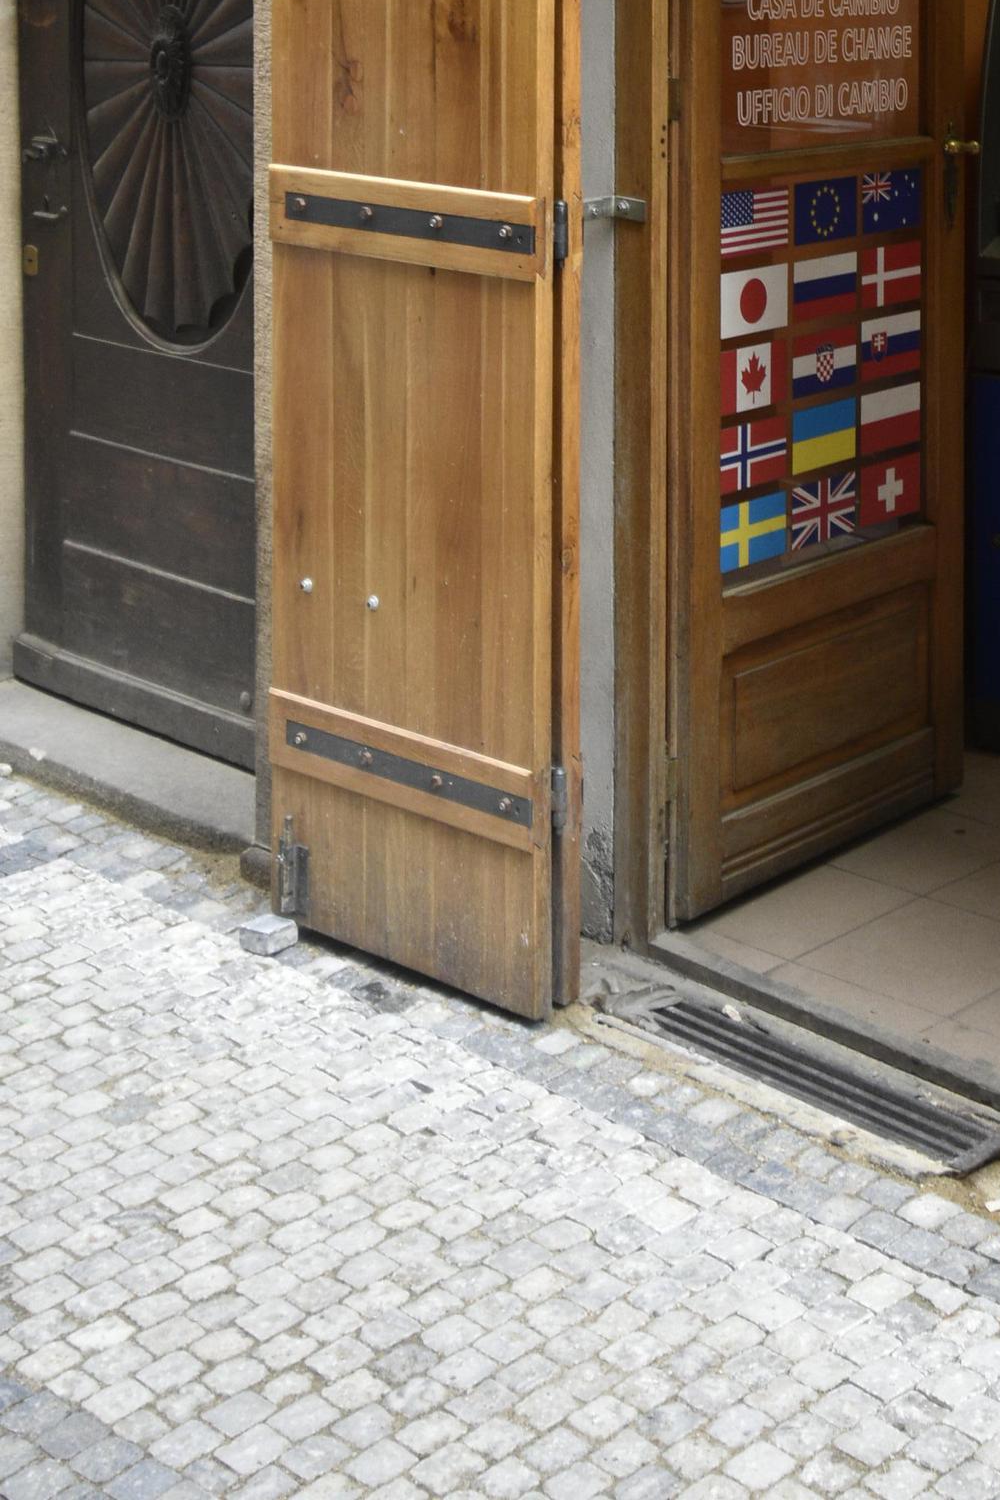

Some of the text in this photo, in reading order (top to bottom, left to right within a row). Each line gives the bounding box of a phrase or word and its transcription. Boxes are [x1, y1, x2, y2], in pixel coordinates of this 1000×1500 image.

[732, 25, 912, 70] BUREAU DE CHANGE
[737, 77, 908, 126] UFFICIO DI CAMBIO
